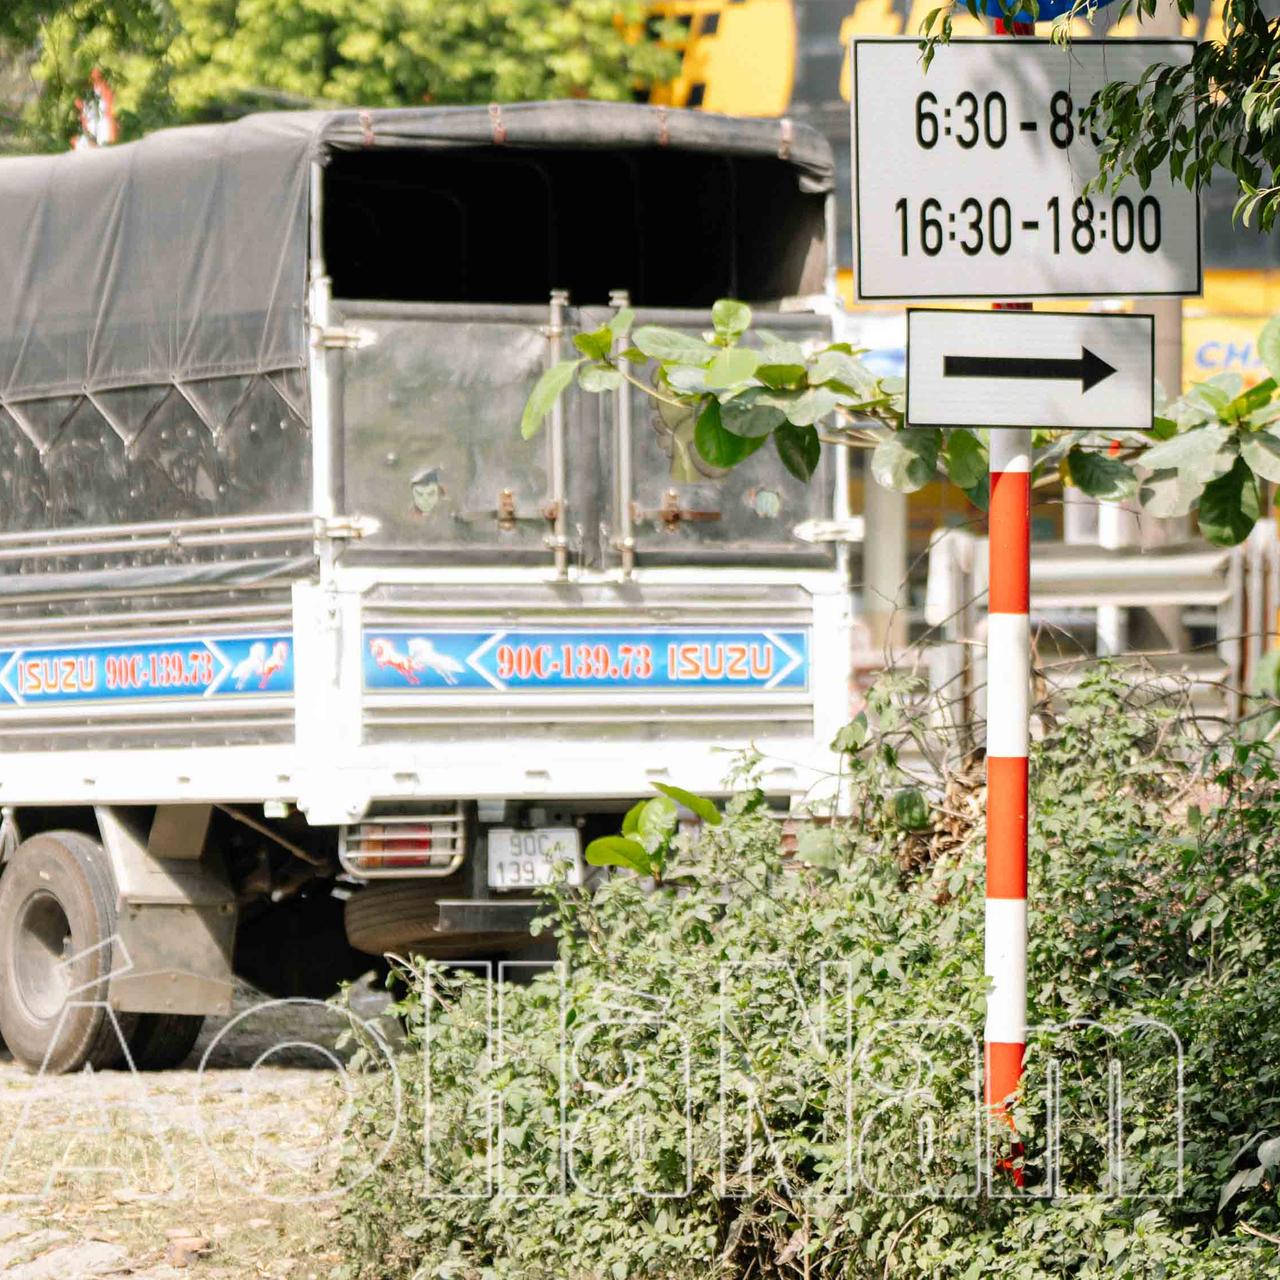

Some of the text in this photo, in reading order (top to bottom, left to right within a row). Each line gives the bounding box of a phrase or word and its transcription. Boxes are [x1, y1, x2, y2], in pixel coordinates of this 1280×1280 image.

[915, 90, 1007, 149] 6:30
[18, 650, 214, 694] ISUZU 90C-139.73
[496, 643, 774, 681] 90C-139.73 ISUZU
[510, 834, 550, 857] 90C
[497, 861, 569, 884] 139.
